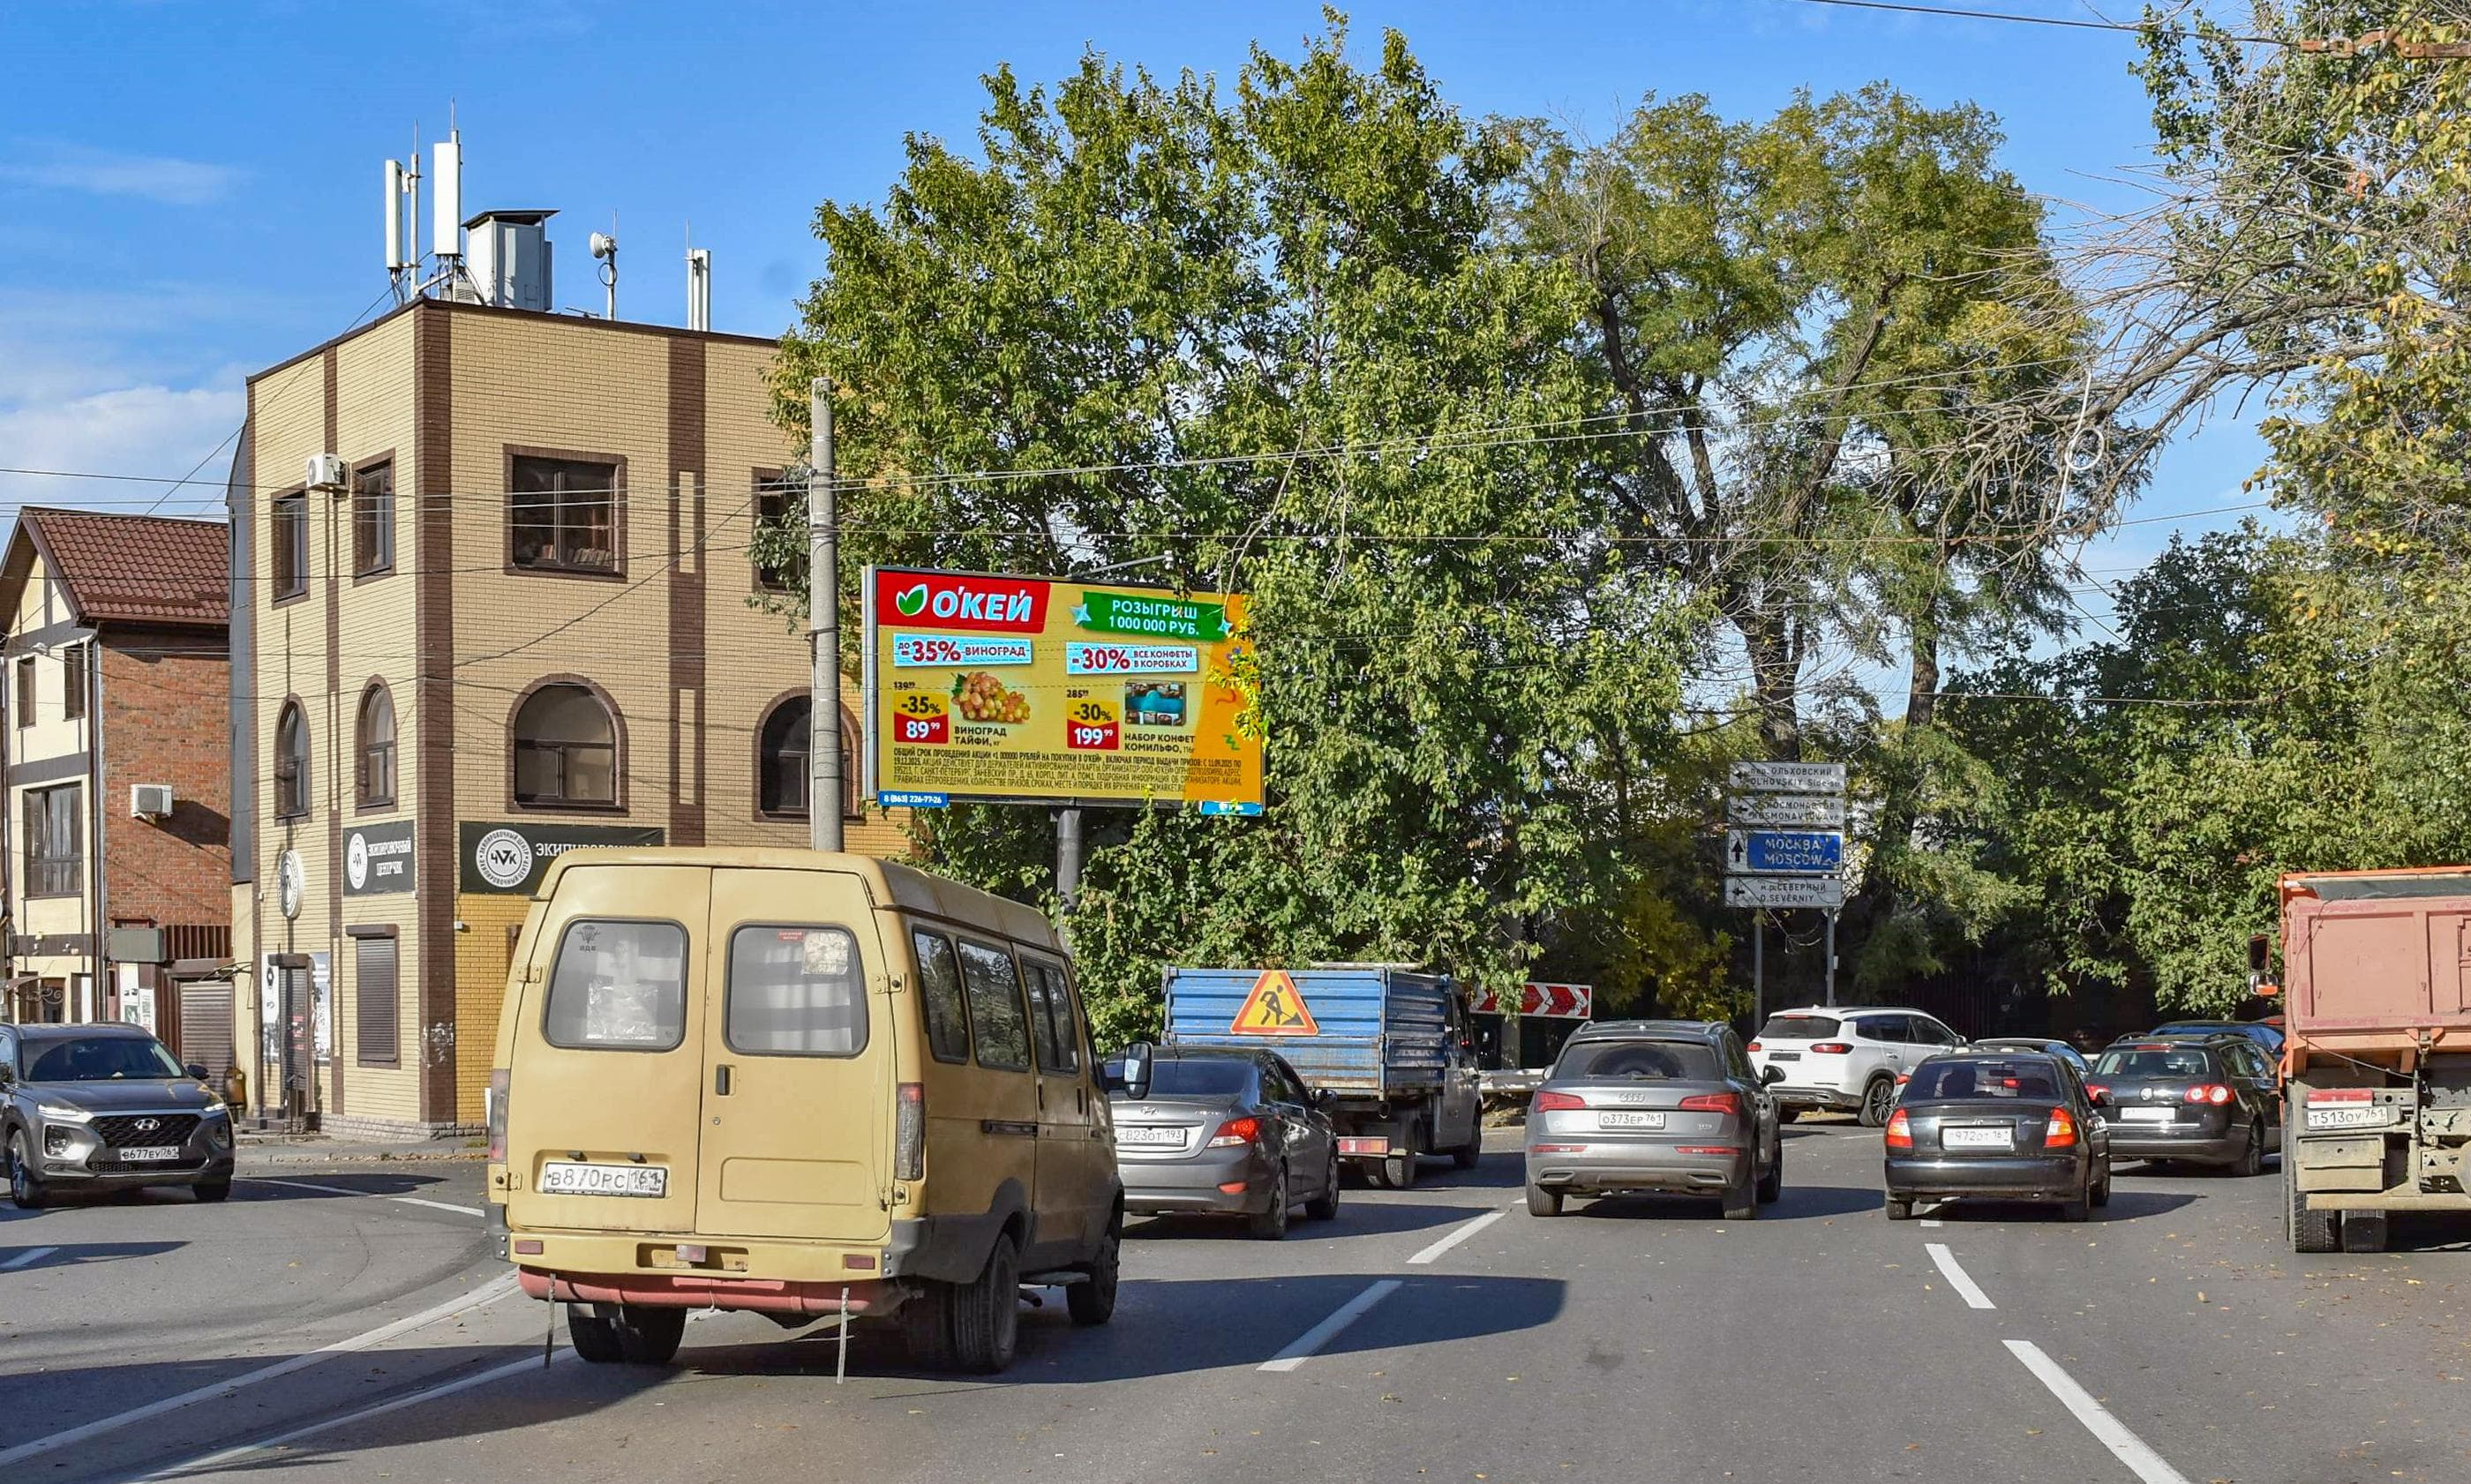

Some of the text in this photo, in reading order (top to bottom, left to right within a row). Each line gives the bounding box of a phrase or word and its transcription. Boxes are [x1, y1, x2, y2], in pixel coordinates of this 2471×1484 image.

[1112, 599, 1198, 619] РОЗЫГРЫШ
[1169, 622, 1199, 635] РУБ.
[965, 647, 1026, 657] ВИНОГРАД
[1072, 648, 1130, 670] -30%
[901, 695, 941, 715] -35%
[1073, 703, 1112, 721] -30%
[954, 726, 1007, 737] ВИНОГРАД
[1124, 733, 1156, 742] НАБОР
[954, 736, 992, 746] ТАЙФИ,
[1124, 743, 1182, 753] КОМИЛЬФО,
[1771, 767, 1832, 776] ОЛЬХОВСКИЙ
[1765, 838, 1821, 851] МОСКВА
[1765, 853, 1822, 866] MOSCOW
